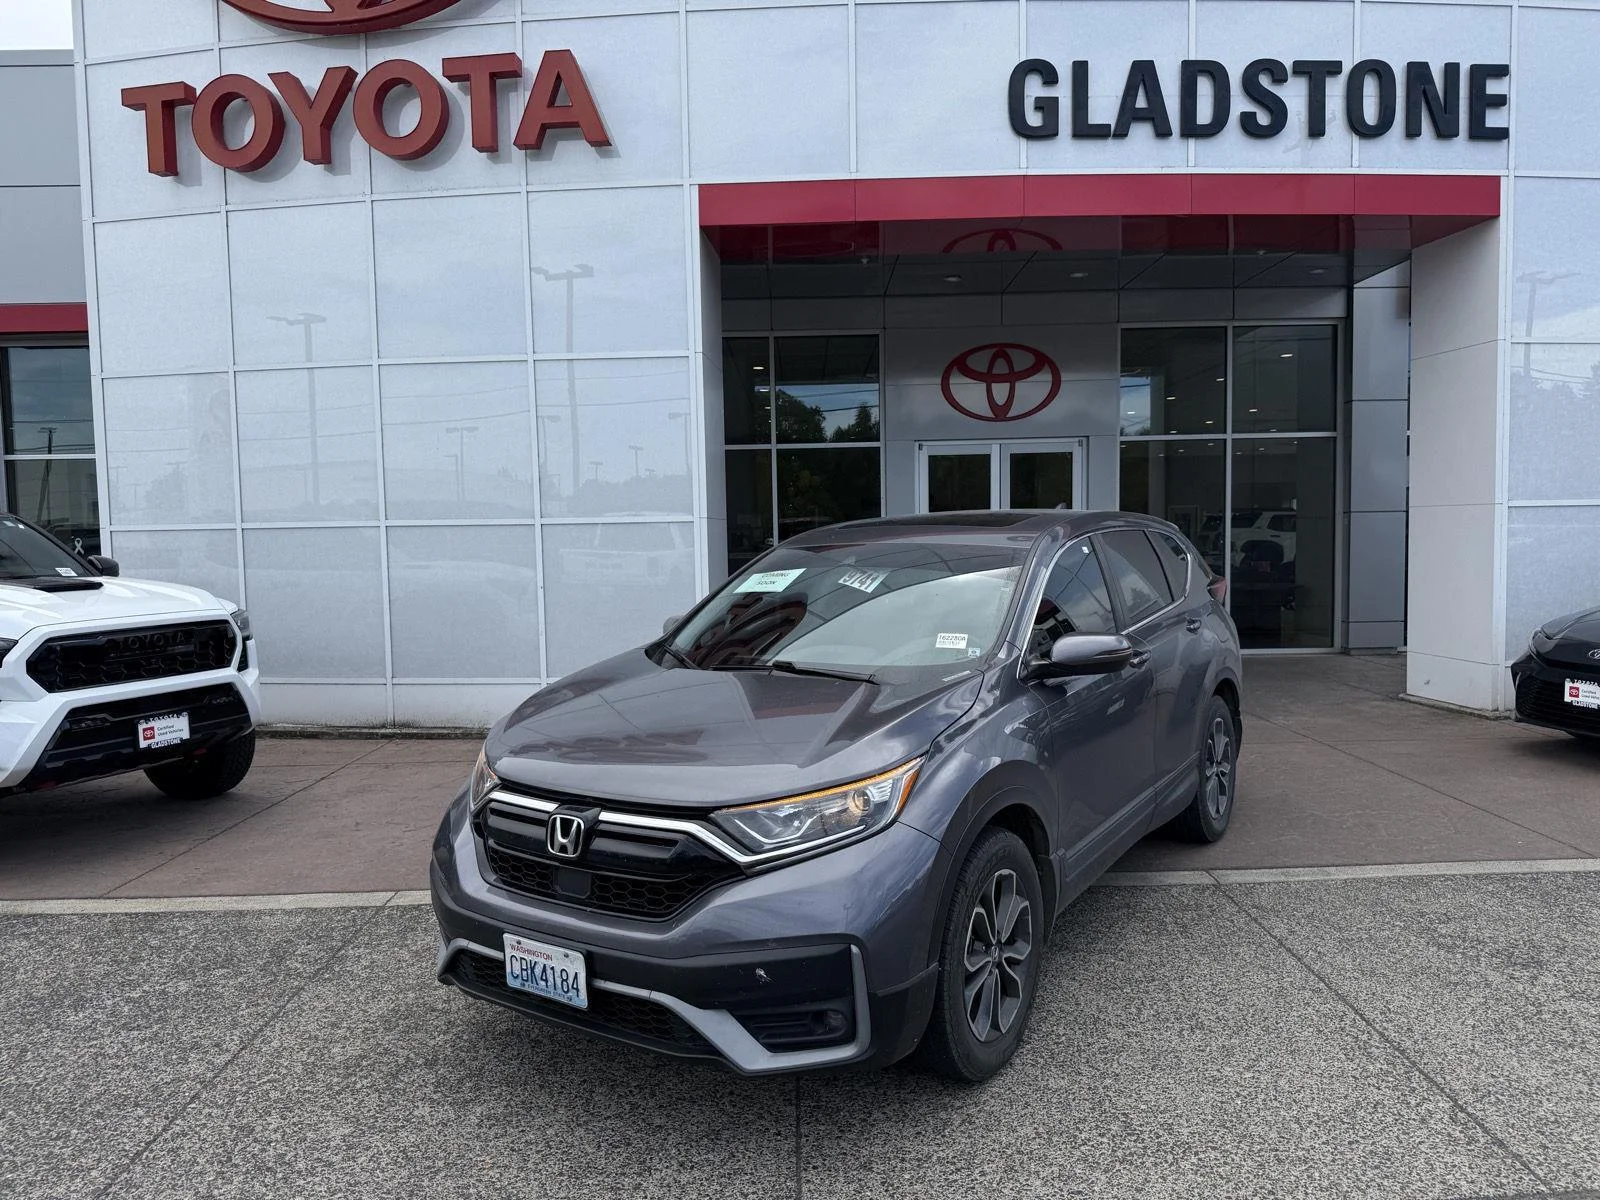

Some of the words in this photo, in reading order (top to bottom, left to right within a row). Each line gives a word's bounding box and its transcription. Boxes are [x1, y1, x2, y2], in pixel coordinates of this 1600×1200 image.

[1008, 58, 1510, 140] GLADSTONE
[121, 49, 612, 177] TOYOTA
[119, 631, 186, 649] TOYOTA
[149, 713, 178, 722] TOYOTA
[157, 724, 174, 732] Certified
[151, 738, 181, 749] GLADSTONE
[510, 943, 553, 962] WASHINGTON
[510, 954, 580, 998] CBK4184
